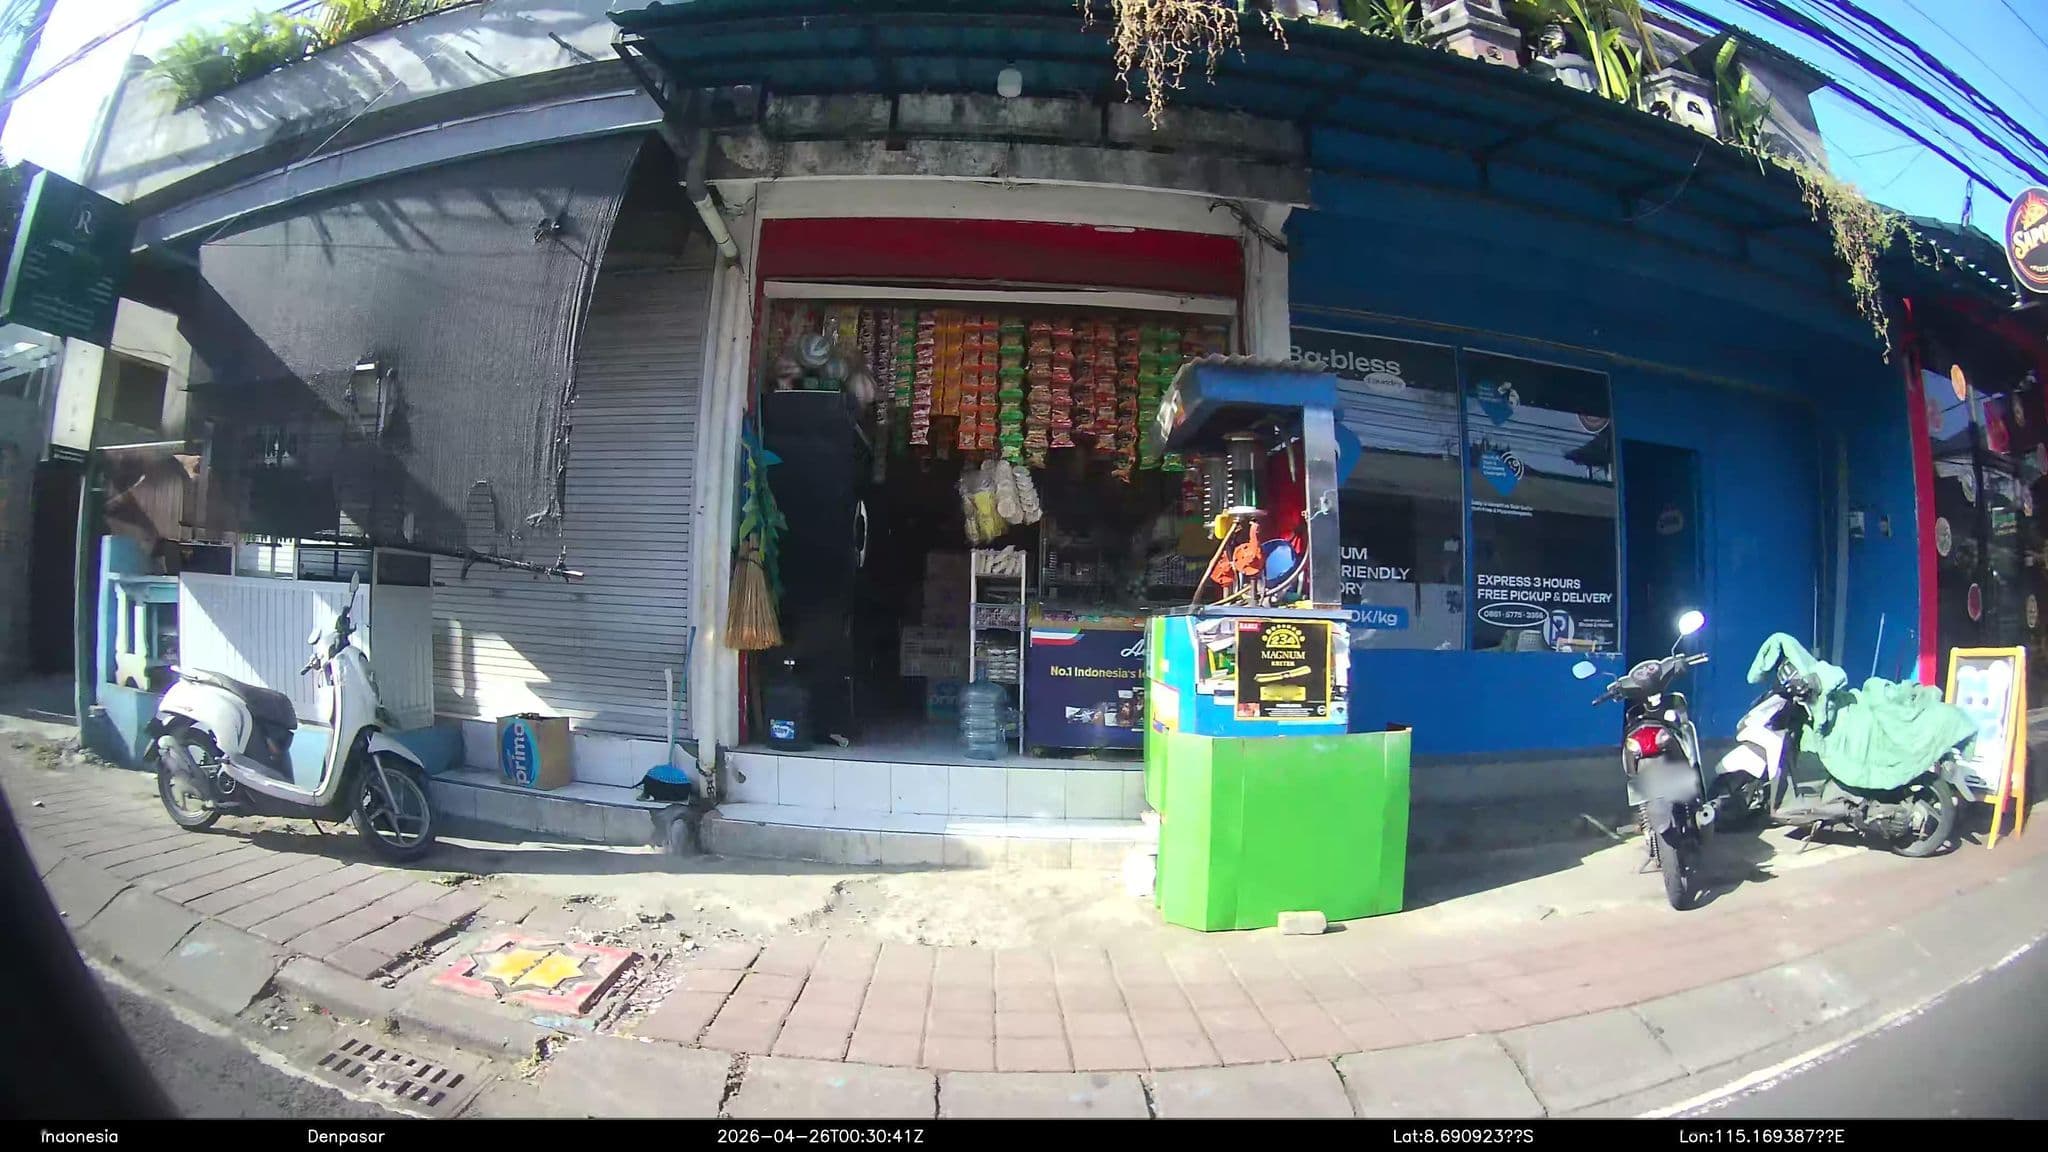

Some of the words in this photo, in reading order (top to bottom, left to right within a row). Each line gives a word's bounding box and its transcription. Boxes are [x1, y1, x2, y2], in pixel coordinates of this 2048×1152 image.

[2013, 220, 2048, 260] SAPO
[1477, 574, 1531, 588] EXPRESS
[1533, 577, 1541, 587] 3
[1543, 578, 1581, 589] HOURS
[1477, 589, 1508, 600] FREE
[1510, 590, 1552, 602] PICKUP
[1553, 592, 1560, 602] &
[1562, 592, 1613, 603] DELIVERY
[1120, 638, 1145, 657] A
[1261, 651, 1306, 660] MAGNUM
[1050, 666, 1072, 676] No.1
[1075, 667, 1136, 679] Indonesia's
[512, 723, 531, 785] primo
